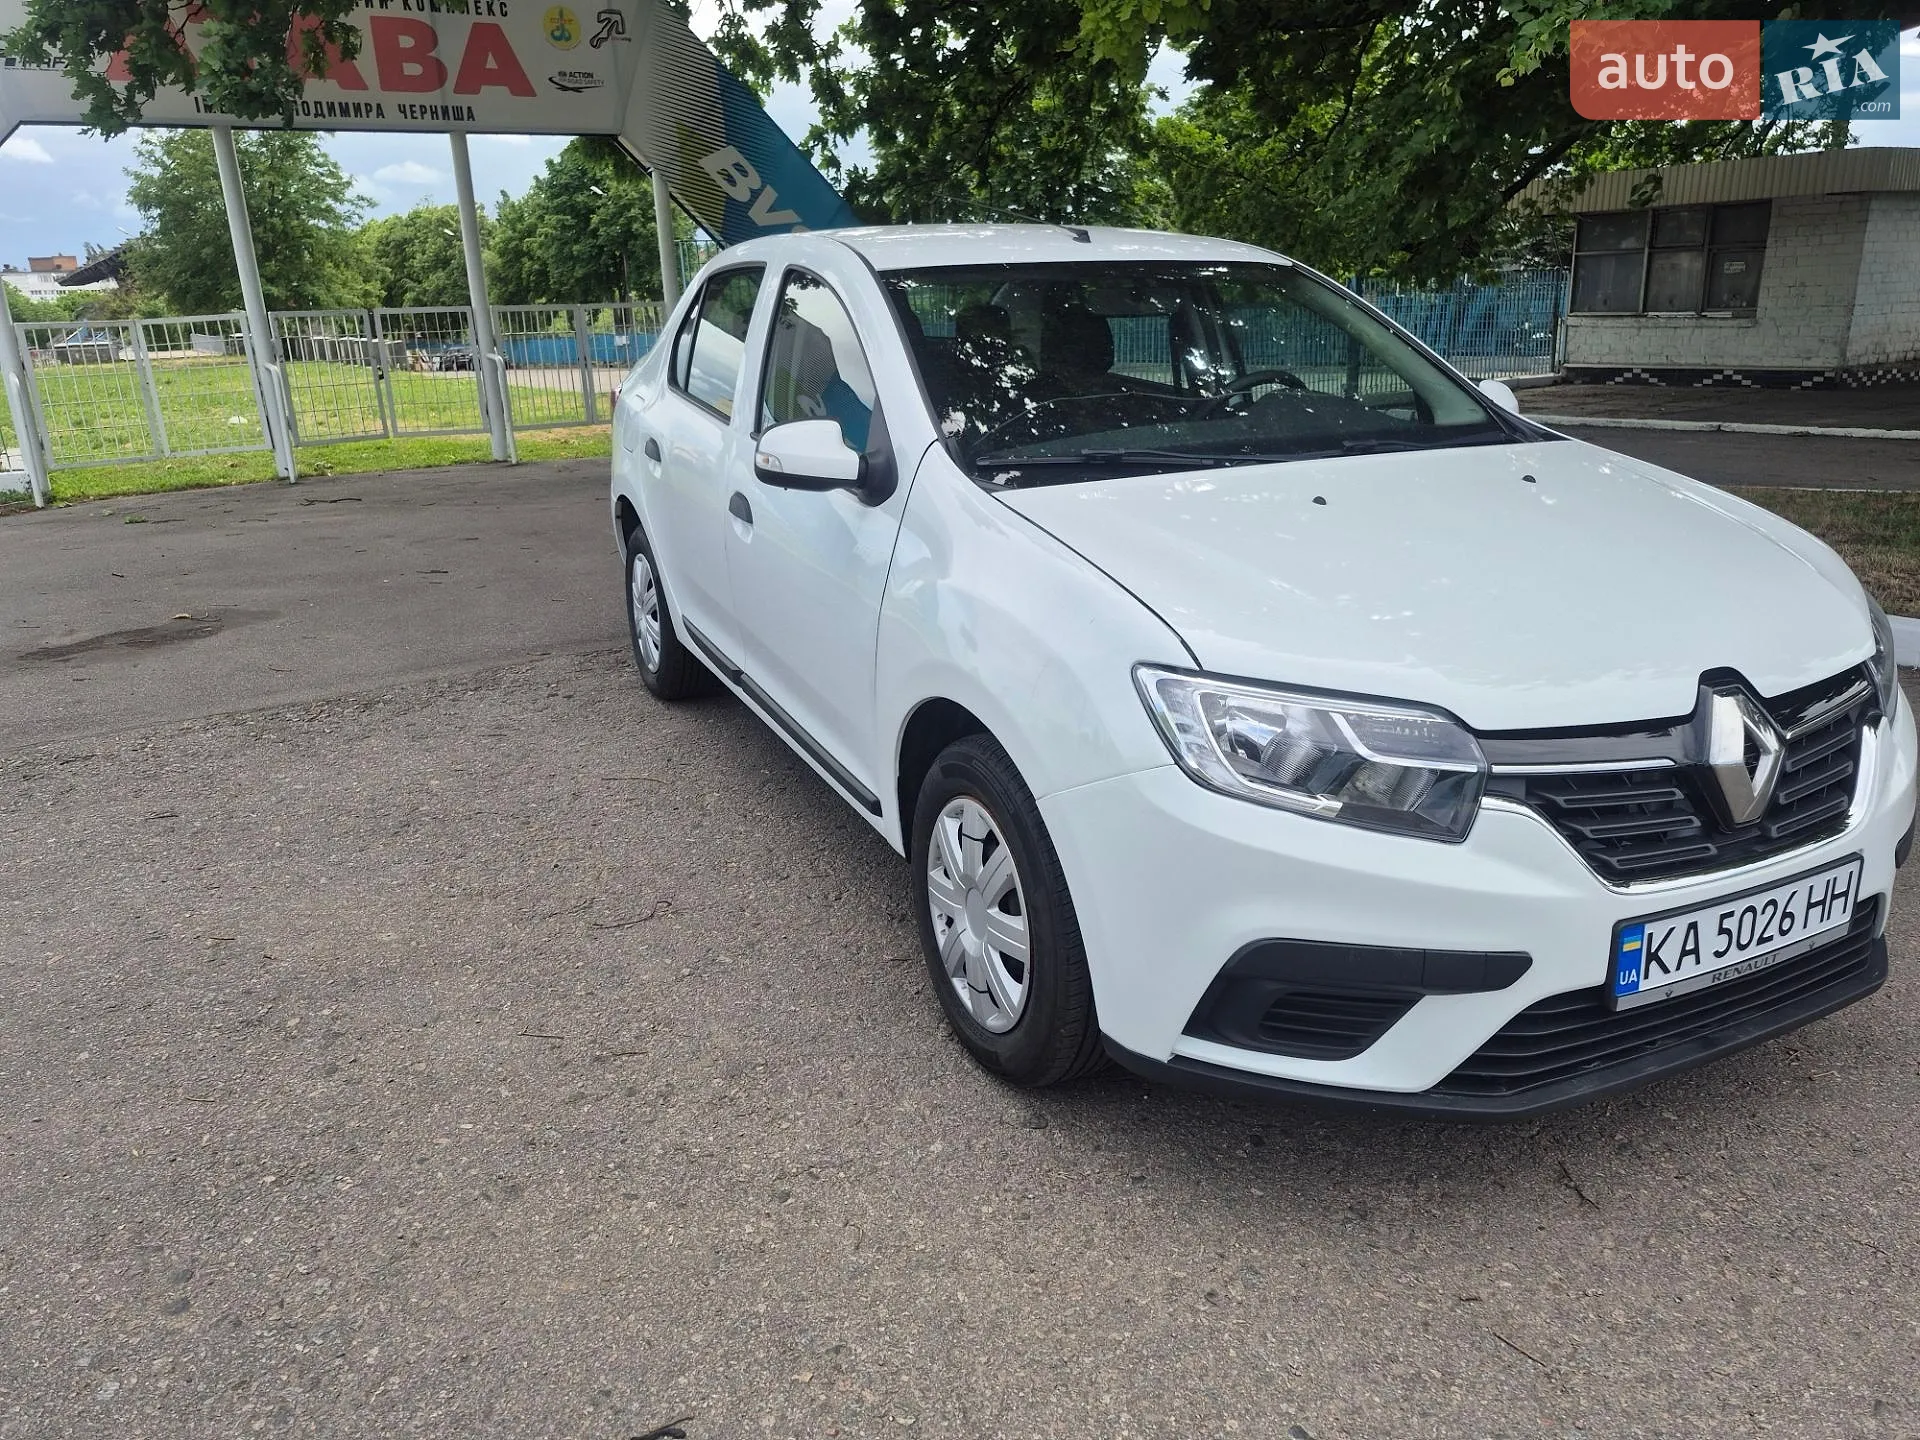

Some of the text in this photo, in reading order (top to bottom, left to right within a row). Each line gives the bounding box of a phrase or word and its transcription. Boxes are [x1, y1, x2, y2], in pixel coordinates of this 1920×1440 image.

[402, 0, 509, 17] КОМЕКС
[398, 103, 476, 122] ЧЕРНИША
[699, 145, 811, 236] BV
[1643, 870, 1854, 981] KA 5026 HH
[1619, 968, 1638, 986] UA
[1711, 952, 1780, 984] RENAULT
